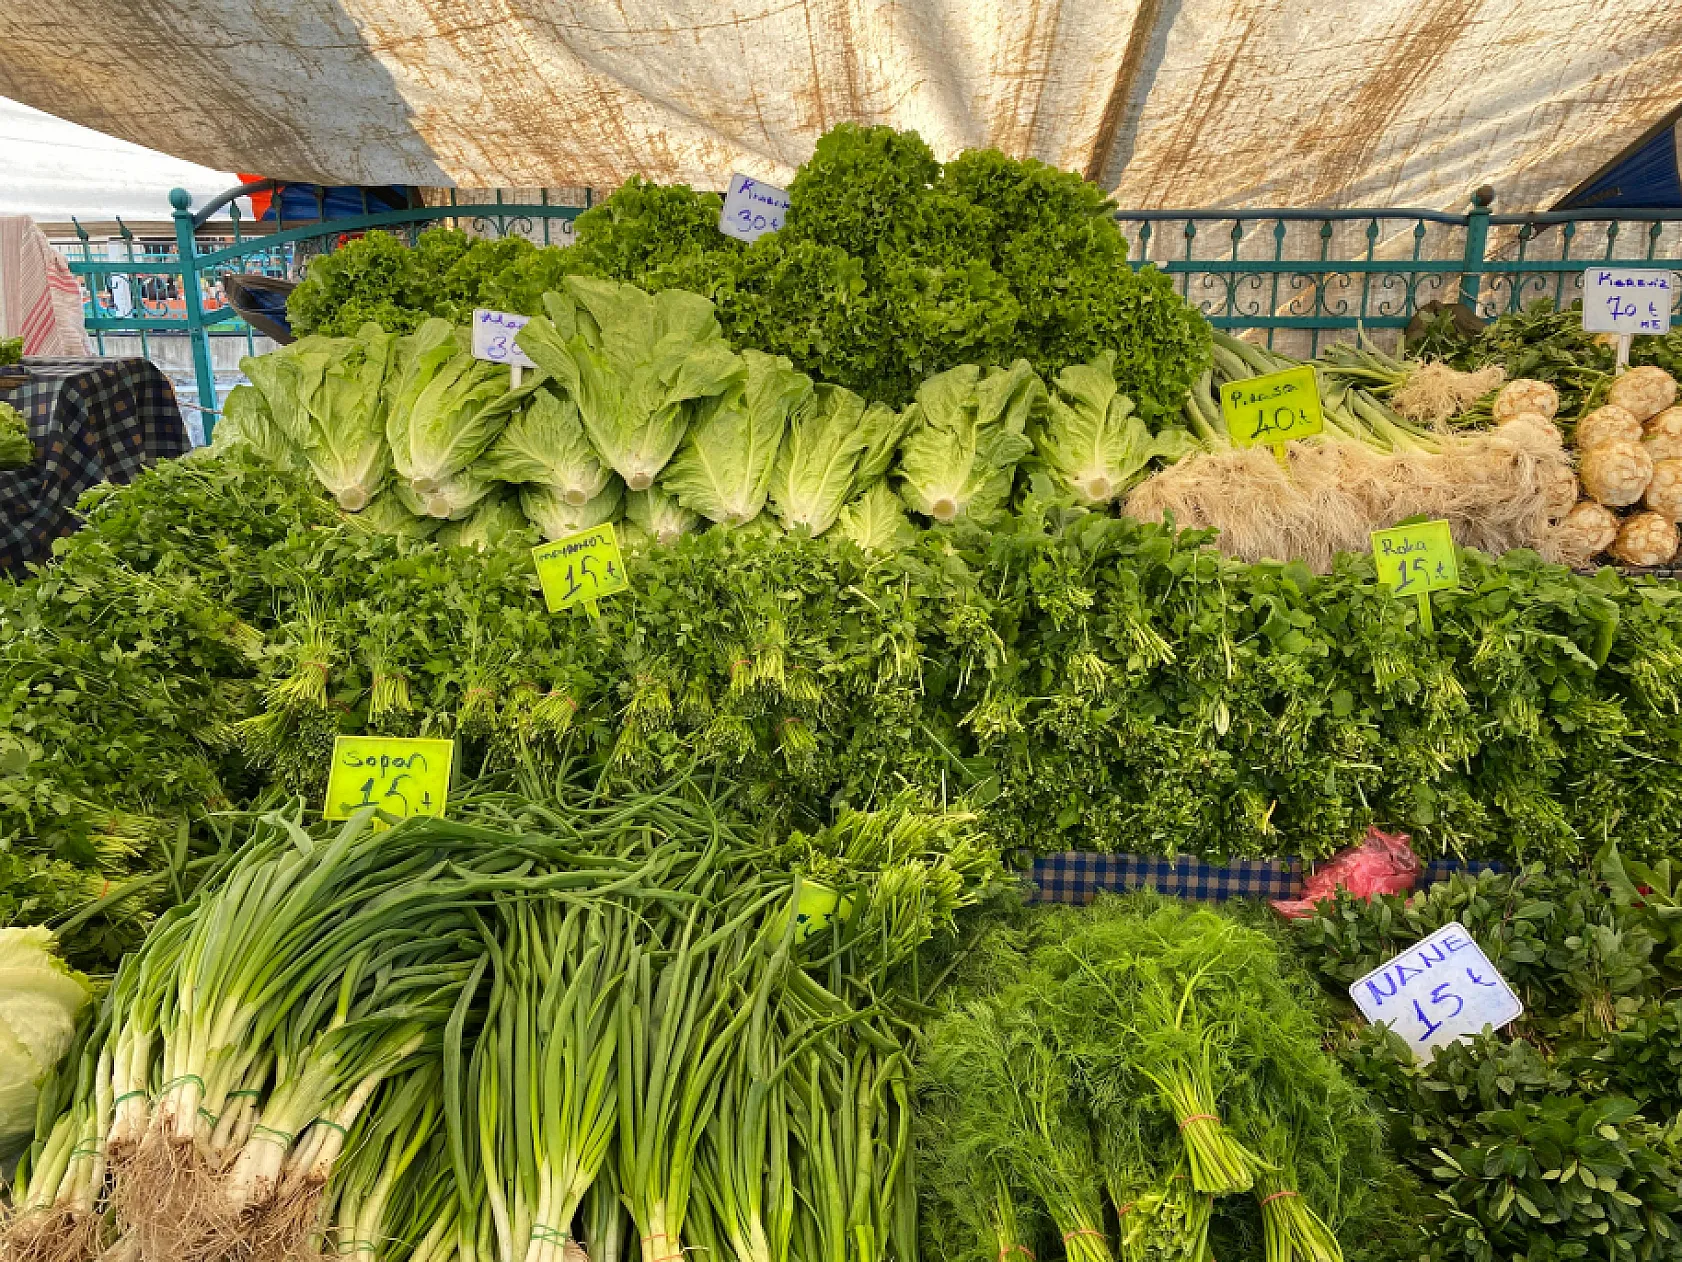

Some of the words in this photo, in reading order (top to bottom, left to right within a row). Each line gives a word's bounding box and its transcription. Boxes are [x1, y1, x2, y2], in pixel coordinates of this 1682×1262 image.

[738, 210, 766, 232] 30
[1606, 296, 1637, 320] 70
[1250, 407, 1295, 439] 40
[562, 555, 600, 600] 15
[1394, 557, 1431, 592] 15
[346, 774, 412, 818] 15
[1365, 934, 1473, 1006] NANE
[1412, 982, 1464, 1042] 15
